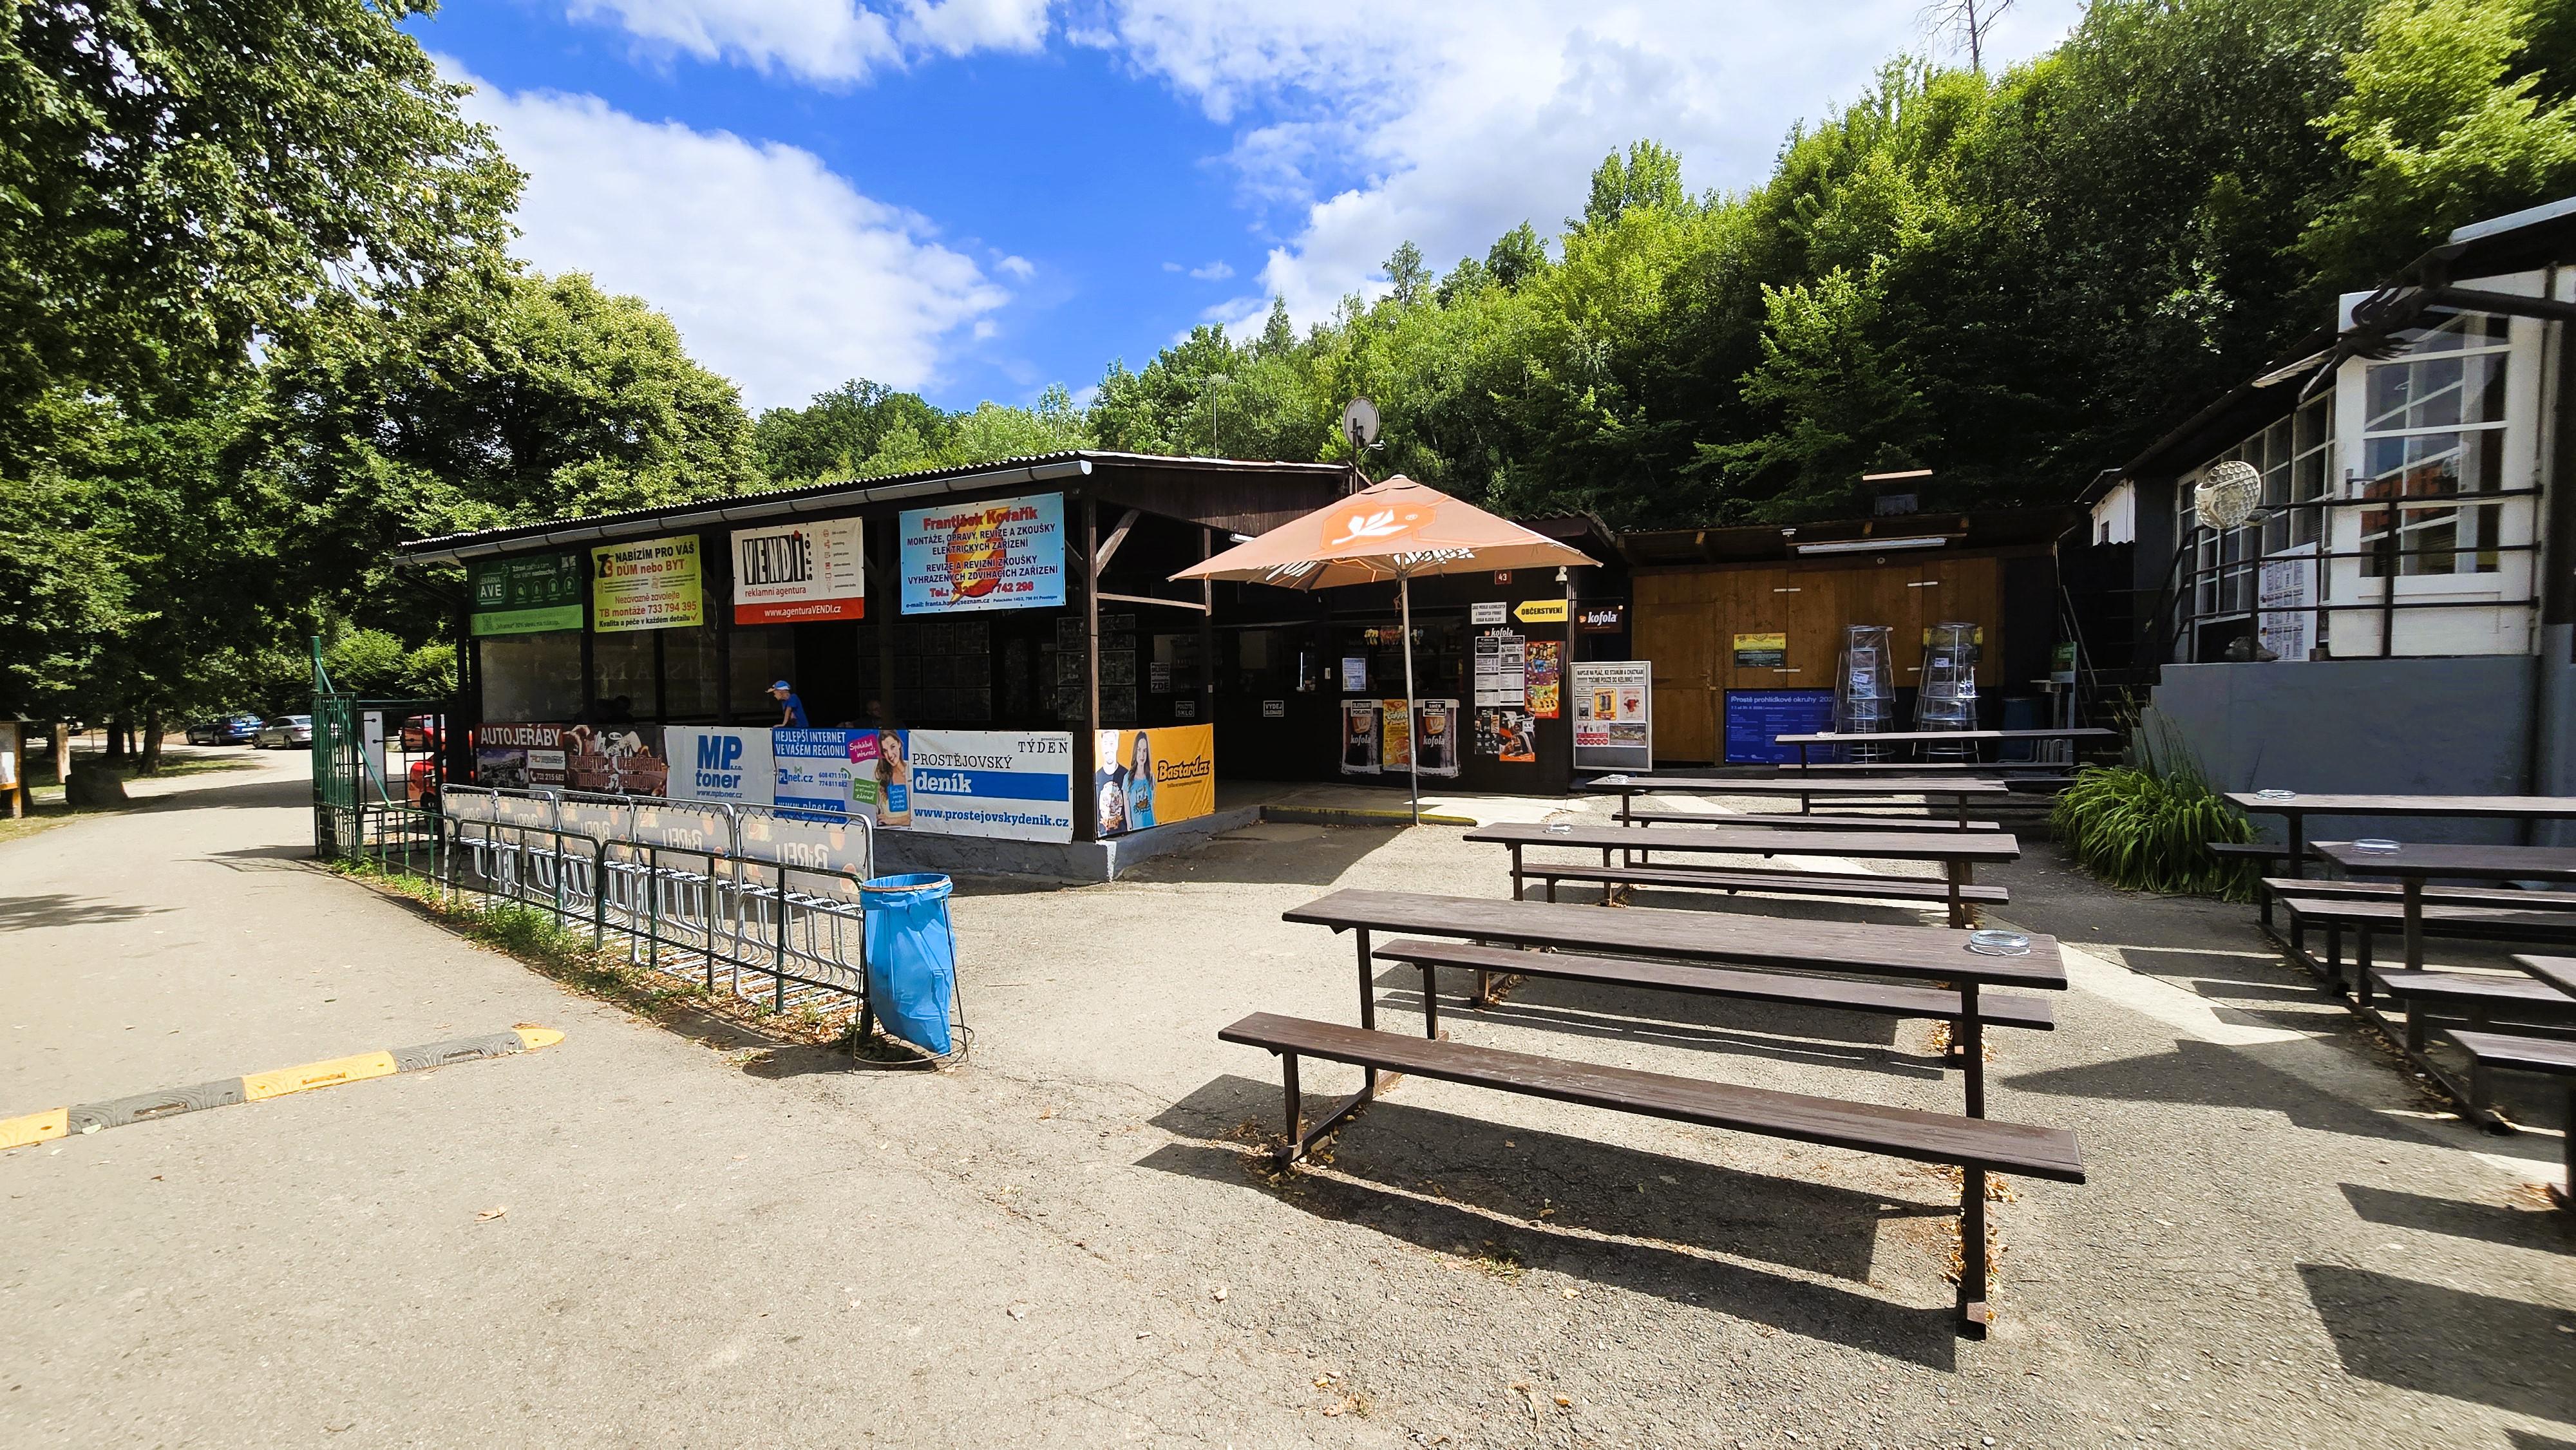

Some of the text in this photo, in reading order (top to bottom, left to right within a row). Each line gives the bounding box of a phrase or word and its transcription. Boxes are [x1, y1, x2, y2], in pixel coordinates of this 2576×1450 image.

[987, 506, 1038, 525] Kovařík
[907, 533, 945, 546] MONTÁŽE,
[947, 532, 978, 543] OPRAVY,
[1017, 523, 1056, 536] ZKOUŠKY
[615, 541, 694, 563] NABÍZÍM PRO VÁŠ
[932, 536, 1028, 555] ELEKTRICKÝCH ZAŘÍZENÍ
[617, 558, 685, 576] DŮM nebo BYT
[926, 562, 954, 572] REVIZE
[998, 554, 1037, 567] ZKOUŠKY
[907, 572, 966, 585] VYHRAZENÝCH
[1019, 563, 1058, 576] ZAŘÍZENÍ
[1498, 573, 1508, 581] 43
[480, 584, 502, 598] AVE
[615, 591, 680, 605] Nezávazně zavolejte
[745, 587, 806, 598] reklamní agentura
[612, 606, 646, 616] montáže
[647, 605, 663, 614] 733
[665, 602, 680, 612] 794
[682, 601, 697, 611] 395
[764, 604, 841, 618] www.agenturaVENDI.cz
[1521, 606, 1563, 615] OBČERSTVENÍ
[599, 619, 619, 628] Kvalita
[670, 614, 690, 623] detailu
[1587, 610, 1617, 626] kofola
[1491, 627, 1513, 637] kofola
[480, 723, 560, 746] AUTOJEŘÁBY
[775, 729, 846, 743] NEJLEPŠÍ INTERNET
[1350, 733, 1372, 746] kofola
[1423, 735, 1446, 748] kofola
[697, 735, 743, 770] MP
[775, 742, 846, 757] VE VAŠEM REGIONU
[1018, 738, 1068, 753] TÝDEN
[912, 753, 1013, 769] PROSTĚJOVSKÝ
[696, 769, 741, 789] toner
[914, 771, 972, 793] deník
[697, 790, 743, 798] www.mptoner.cz
[914, 807, 1069, 827] www.prostejovskydenik.cz
